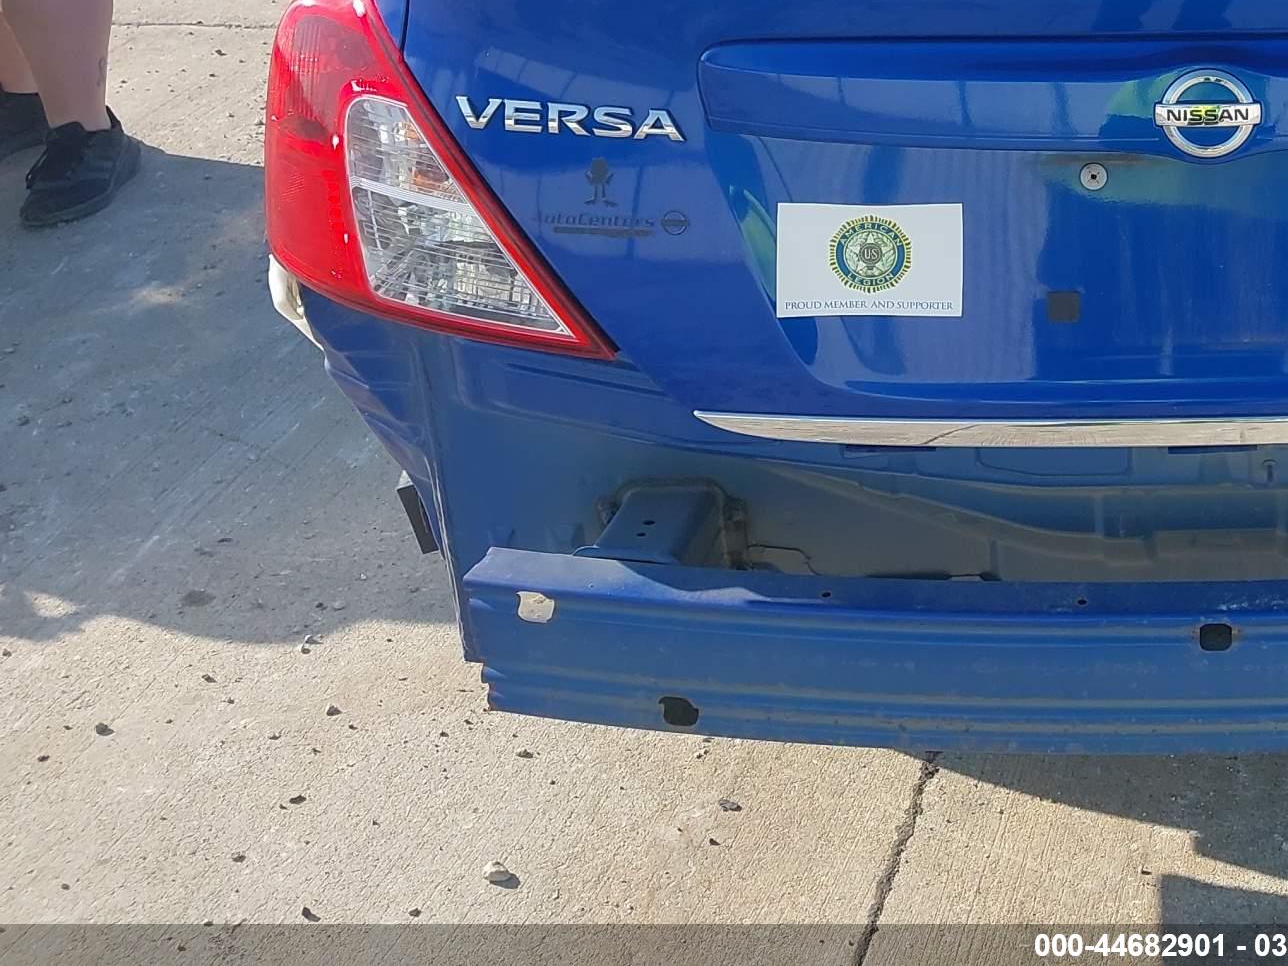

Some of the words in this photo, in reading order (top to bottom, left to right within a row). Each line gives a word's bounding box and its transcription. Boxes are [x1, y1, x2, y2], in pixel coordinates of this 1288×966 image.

[455, 95, 685, 141] VERSA
[1166, 107, 1249, 123] NISSAN
[840, 222, 903, 247] AMERICAN
[864, 248, 879, 260] US
[847, 273, 895, 286] LEGION
[785, 301, 822, 310] PROUD
[824, 300, 867, 309] MEMBER
[870, 300, 895, 309] AND
[896, 301, 953, 311] SUPPORTER
